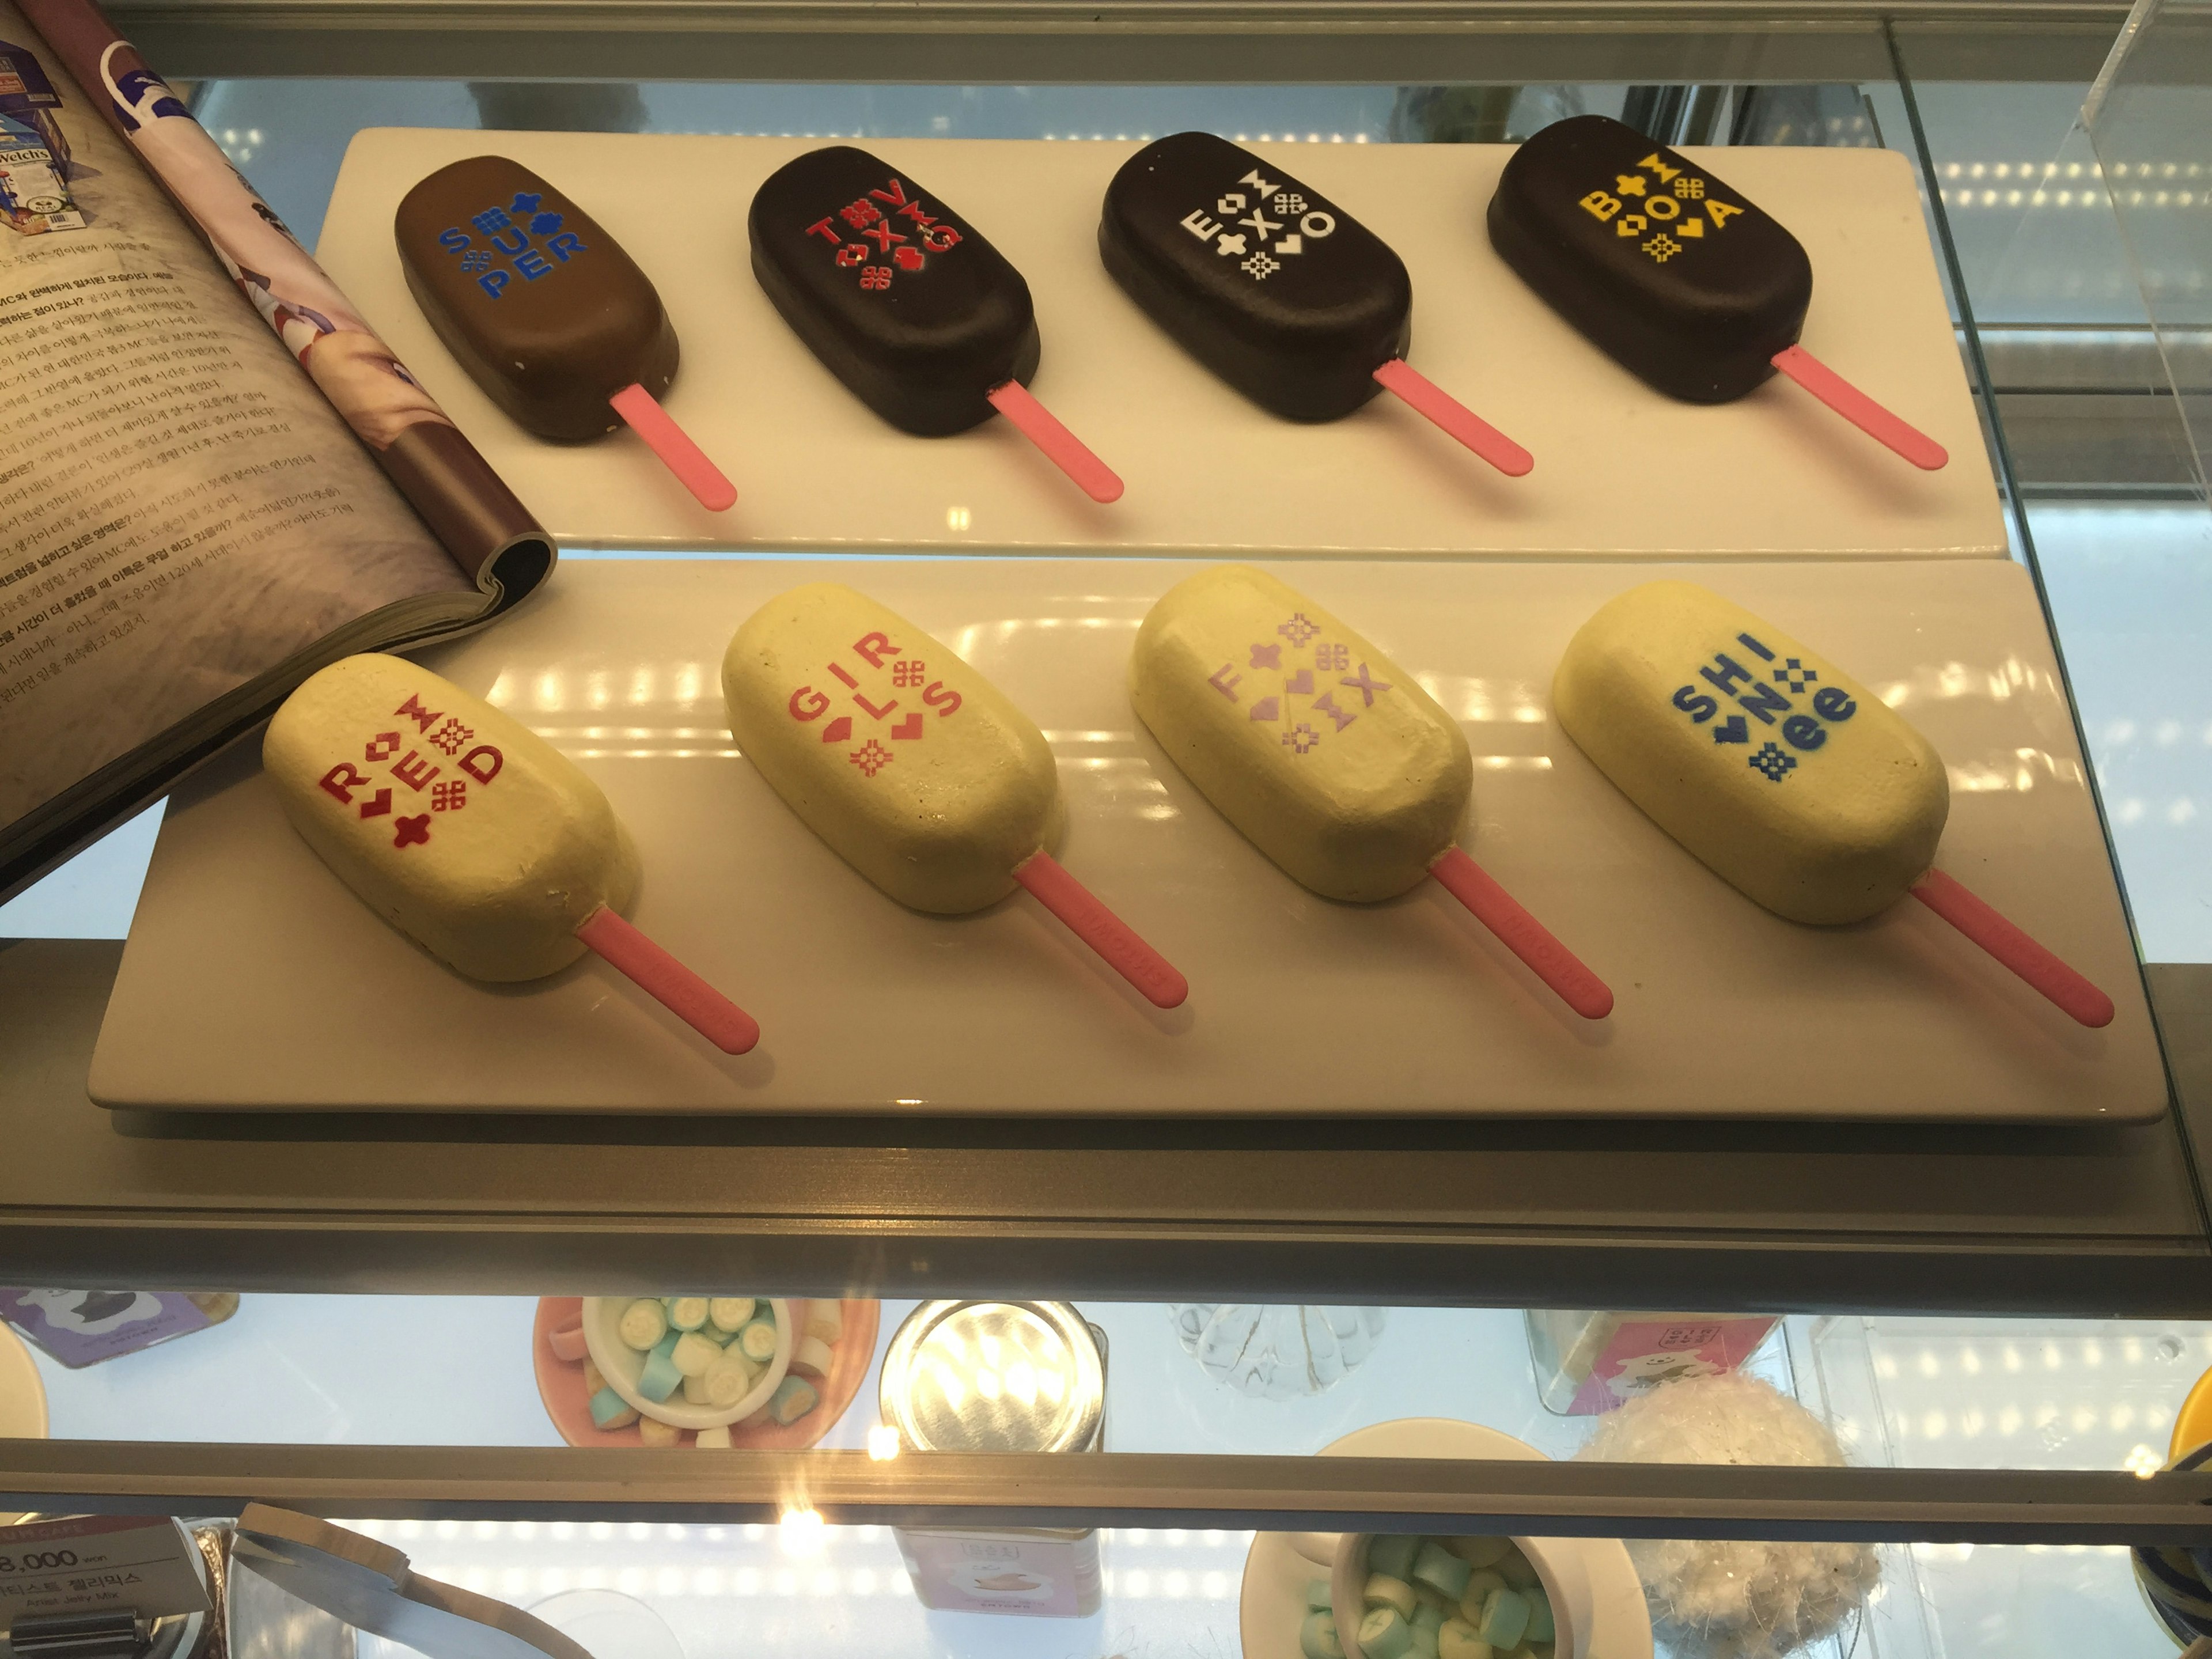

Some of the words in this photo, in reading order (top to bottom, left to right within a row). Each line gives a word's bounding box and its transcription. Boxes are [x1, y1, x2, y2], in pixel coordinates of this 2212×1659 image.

[29, 282, 73, 298] 완벽하게
[73, 276, 106, 288] 일치된
[108, 272, 152, 282] 모습이다.
[0, 311, 33, 327] 력하는
[32, 304, 56, 316] 점이
[56, 297, 84, 310] 있나?
[25, 325, 49, 339] 삶을
[100, 305, 136, 318] 때문에
[15, 344, 51, 361] 차이를
[53, 332, 91, 349] 어떻게
[58, 348, 105, 368] 대한민국
[30, 389, 44, 400] 그
[44, 375, 82, 395] 반열에
[123, 351, 170, 369] 그들처럼
[219, 346, 231, 354] 위
[66, 391, 100, 408] MC가
[101, 381, 126, 395] 되기
[128, 374, 154, 387] 위한
[156, 366, 190, 381] 시간은
[20, 427, 59, 449] 10년이
[59, 417, 84, 431] 지나
[86, 396, 145, 422] 되돌아보니
[146, 393, 160, 403] 난
[160, 386, 184, 397] 아직
[78, 432, 105, 448] 하면
[105, 426, 119, 437] 더
[122, 410, 169, 432] 재미있게
[184, 403, 197, 412] 수
[198, 393, 238, 410] 있을까?
[20, 504, 47, 522] 관련
[47, 482, 95, 510] 인터뷰가
[96, 471, 121, 488] 있어
[217, 433, 232, 444] 난
[231, 427, 268, 440] 죽기로
[29, 475, 56, 492] 내린
[175, 419, 213, 434] 제대로
[36, 545, 73, 568] 넓히고
[71, 533, 94, 552] 싶은
[93, 514, 132, 540] 영역은?
[161, 483, 207, 507] 시도하지
[233, 464, 270, 480] 분야는
[270, 454, 317, 470] 연기인데
[15, 528, 51, 552] 생각이
[29, 573, 67, 599] 경험할
[66, 567, 80, 579] 수
[79, 552, 106, 573] 있어
[105, 533, 151, 559] MC에도
[149, 514, 187, 539] 도움이
[16, 609, 50, 635] 시간이
[50, 603, 64, 616] 더
[63, 585, 98, 609] 흘렀을
[97, 577, 112, 590] 때
[111, 560, 146, 582] 이특은
[145, 547, 170, 565] 무얼
[170, 537, 195, 553] 하고
[193, 519, 233, 543] 있을까?
[95, 599, 121, 620] 그때
[120, 573, 169, 607] 즈음이면
[168, 556, 204, 581] 120세
[204, 533, 252, 562] 시대이지
[250, 519, 293, 543] 않을까?
[294, 509, 329, 524] 아마도
[36, 662, 62, 681] 일을
[62, 635, 111, 667] 계속하고
[109, 612, 150, 641] 있겠지.
[68, 1573, 143, 1591] 젤리믹스
[82, 1555, 107, 1563] won
[96, 1591, 120, 1600] Mix
